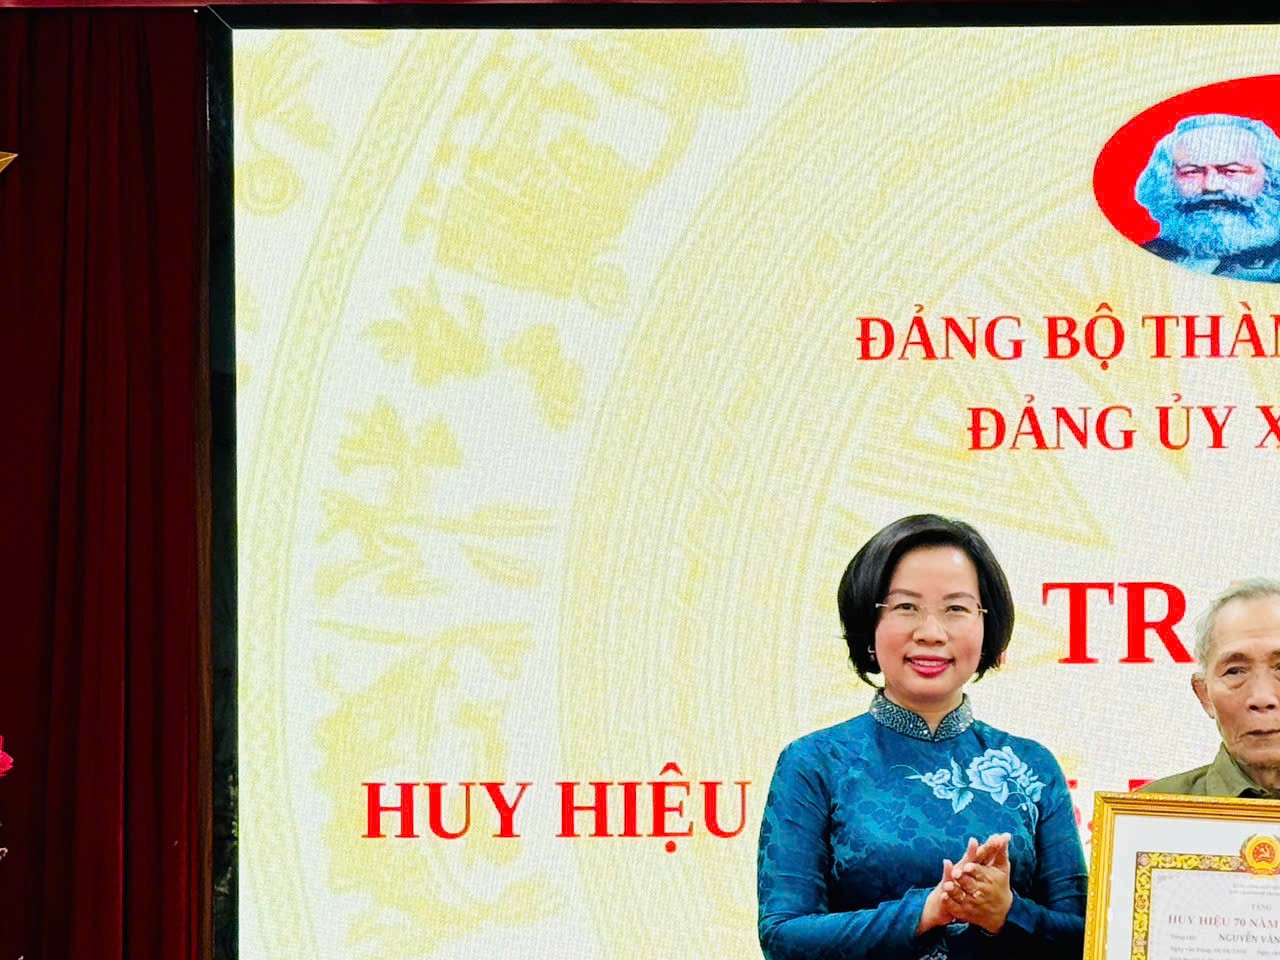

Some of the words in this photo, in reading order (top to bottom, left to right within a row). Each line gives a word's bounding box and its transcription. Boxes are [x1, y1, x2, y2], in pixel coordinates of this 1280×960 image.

[856, 304, 1024, 361] ĐẢNG
[1046, 303, 1126, 370] BỘ
[967, 395, 1135, 451] ĐẢNG
[1158, 394, 1233, 451] ỦY
[361, 781, 533, 840] HUY
[556, 762, 751, 853] HIỆU
